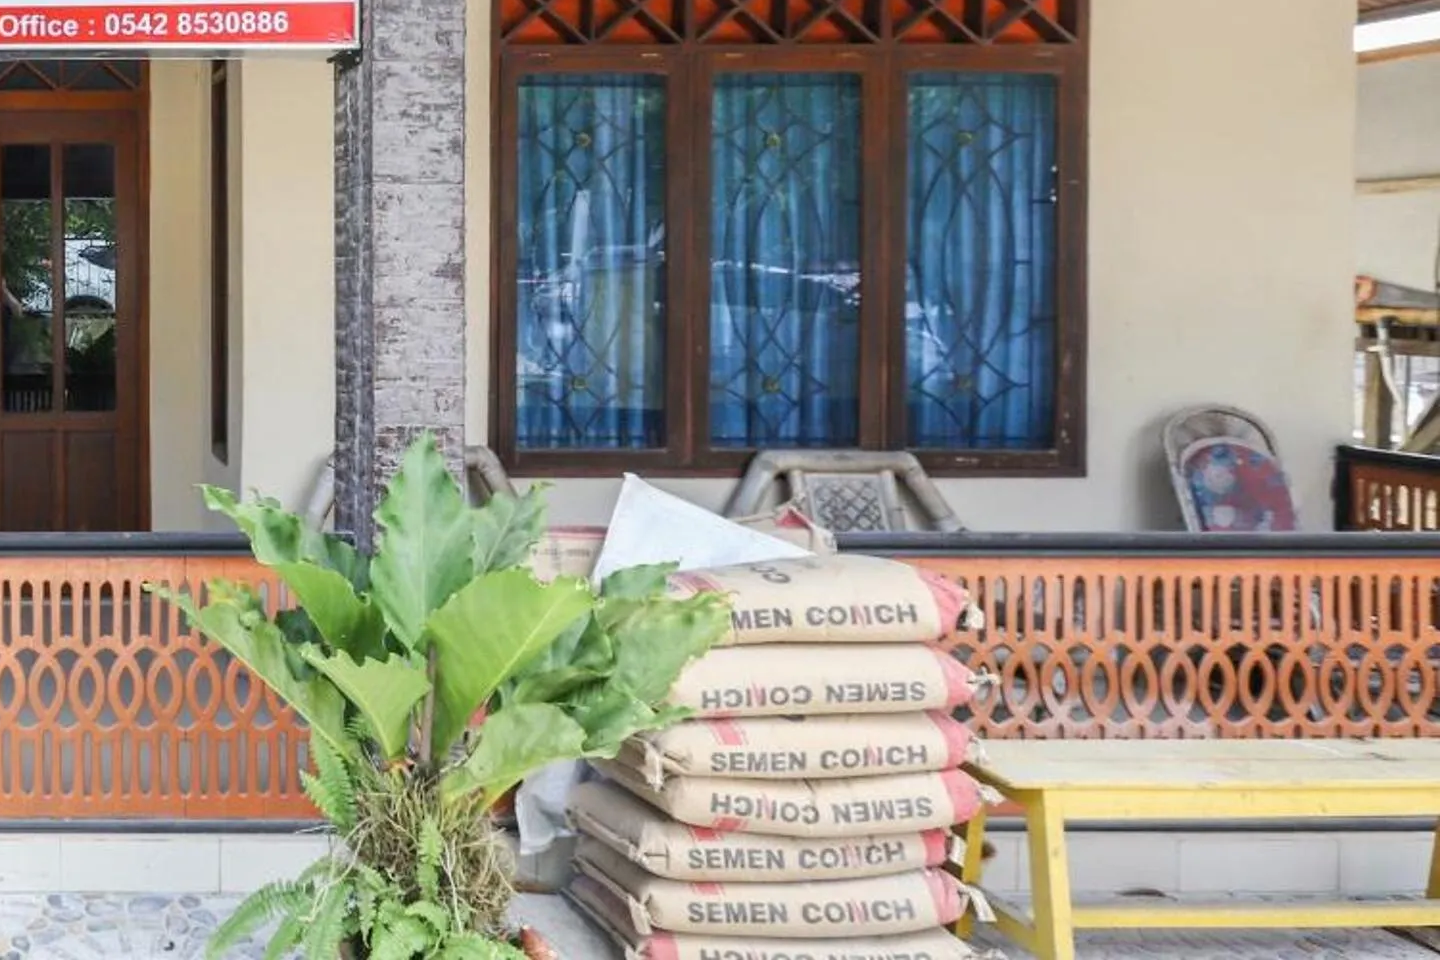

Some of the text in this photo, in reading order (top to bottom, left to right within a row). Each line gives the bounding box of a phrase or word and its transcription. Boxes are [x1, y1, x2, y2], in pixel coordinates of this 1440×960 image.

[104, 13, 168, 35] 0542
[177, 11, 289, 35] 8530886
[731, 603, 918, 631] MEN CONCH
[701, 681, 926, 709] SEMEN CONCH
[710, 744, 928, 773] SEMEN CONCH
[710, 792, 934, 825] SEMEN CONCH
[688, 840, 906, 870] SEMEN CONCH
[687, 897, 916, 924] SEMEN CONCH
